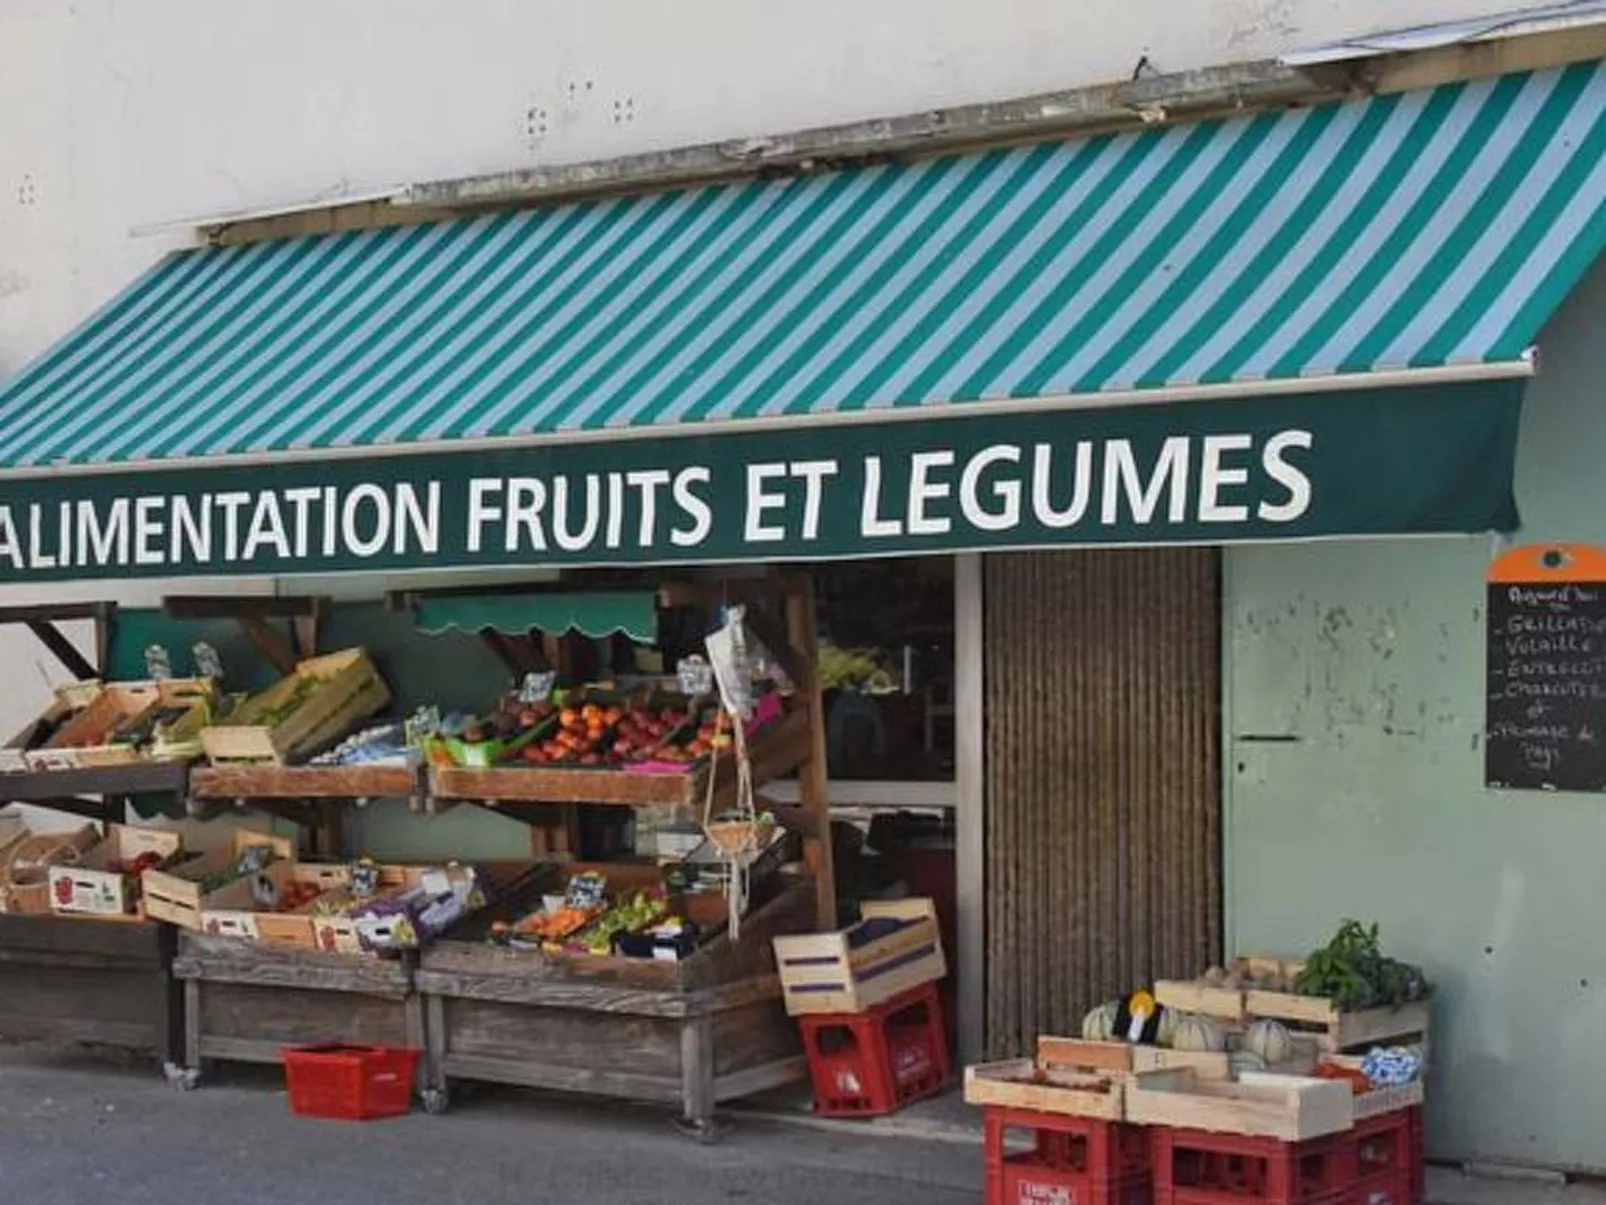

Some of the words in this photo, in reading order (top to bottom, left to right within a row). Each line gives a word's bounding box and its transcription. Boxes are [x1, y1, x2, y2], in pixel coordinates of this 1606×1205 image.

[0, 482, 440, 569] ALIMENTATION
[468, 467, 711, 552] FRUITS
[745, 460, 837, 541] ET
[862, 430, 1312, 536] LEGUMES
